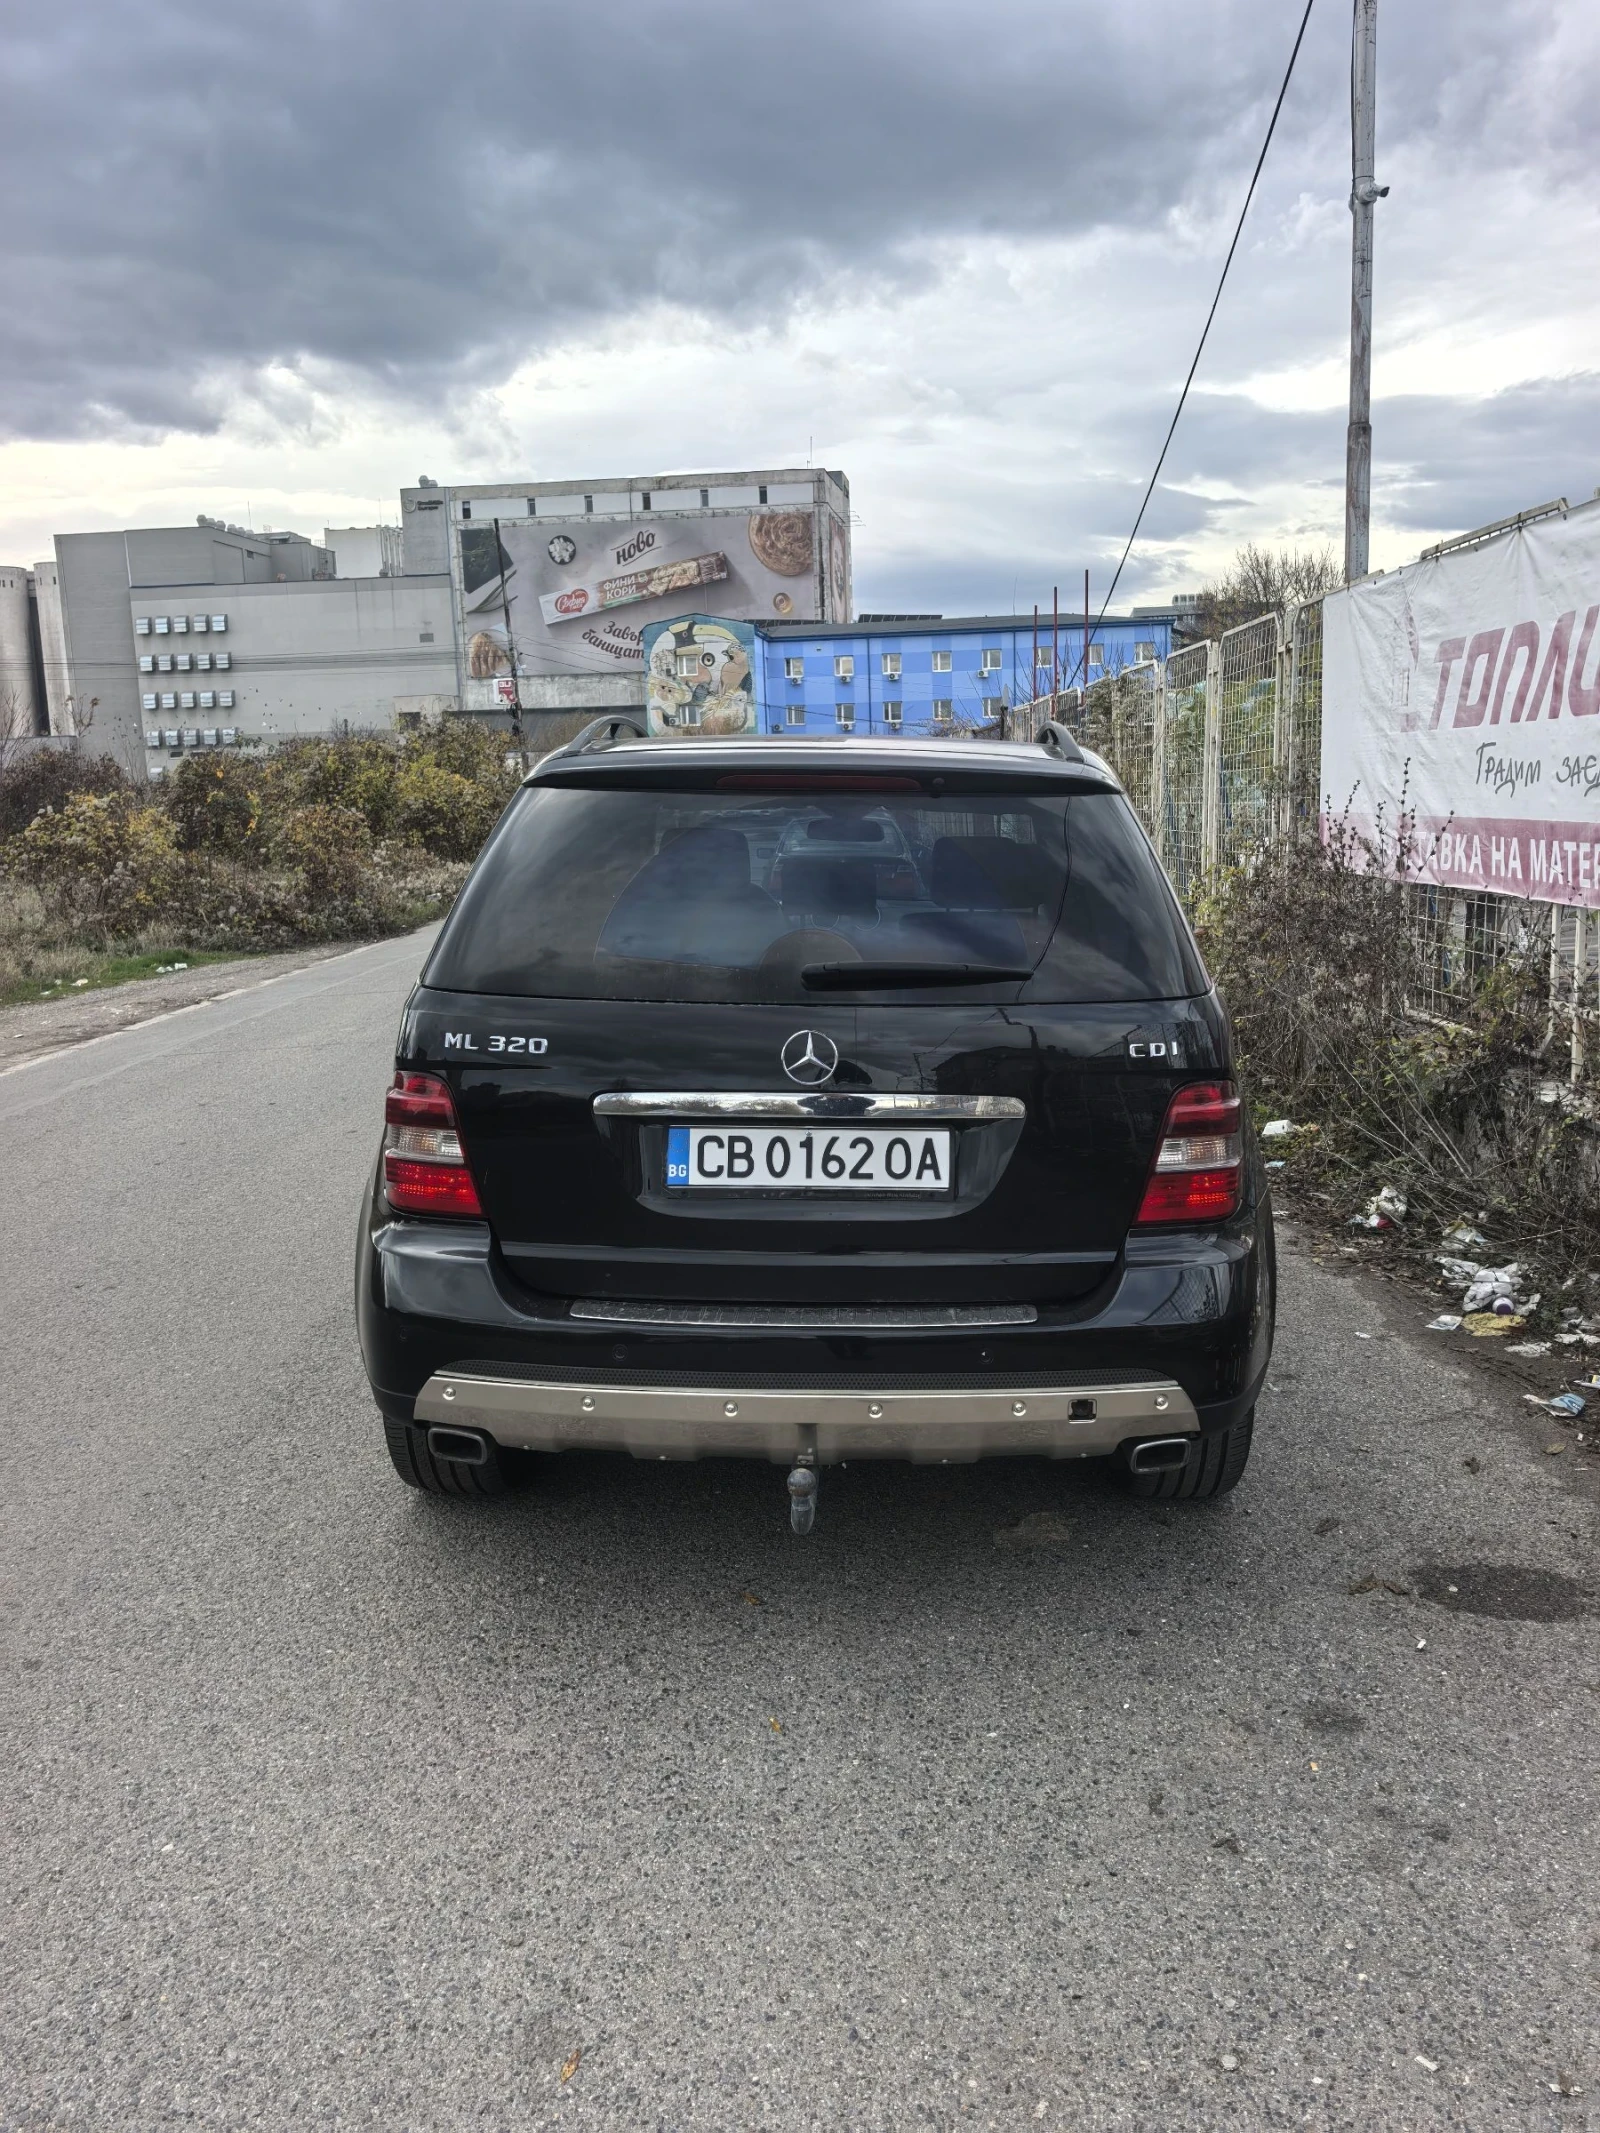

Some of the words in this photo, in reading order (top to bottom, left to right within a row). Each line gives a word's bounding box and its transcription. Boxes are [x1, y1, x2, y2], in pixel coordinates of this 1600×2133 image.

[603, 575, 636, 591] ФИНИ
[606, 585, 637, 600] КОРИ
[1491, 835, 1522, 879] НА
[444, 1032, 479, 1050] ML
[487, 1035, 548, 1054] 320
[1129, 1041, 1178, 1058] CDI
[668, 1164, 687, 1178] BG
